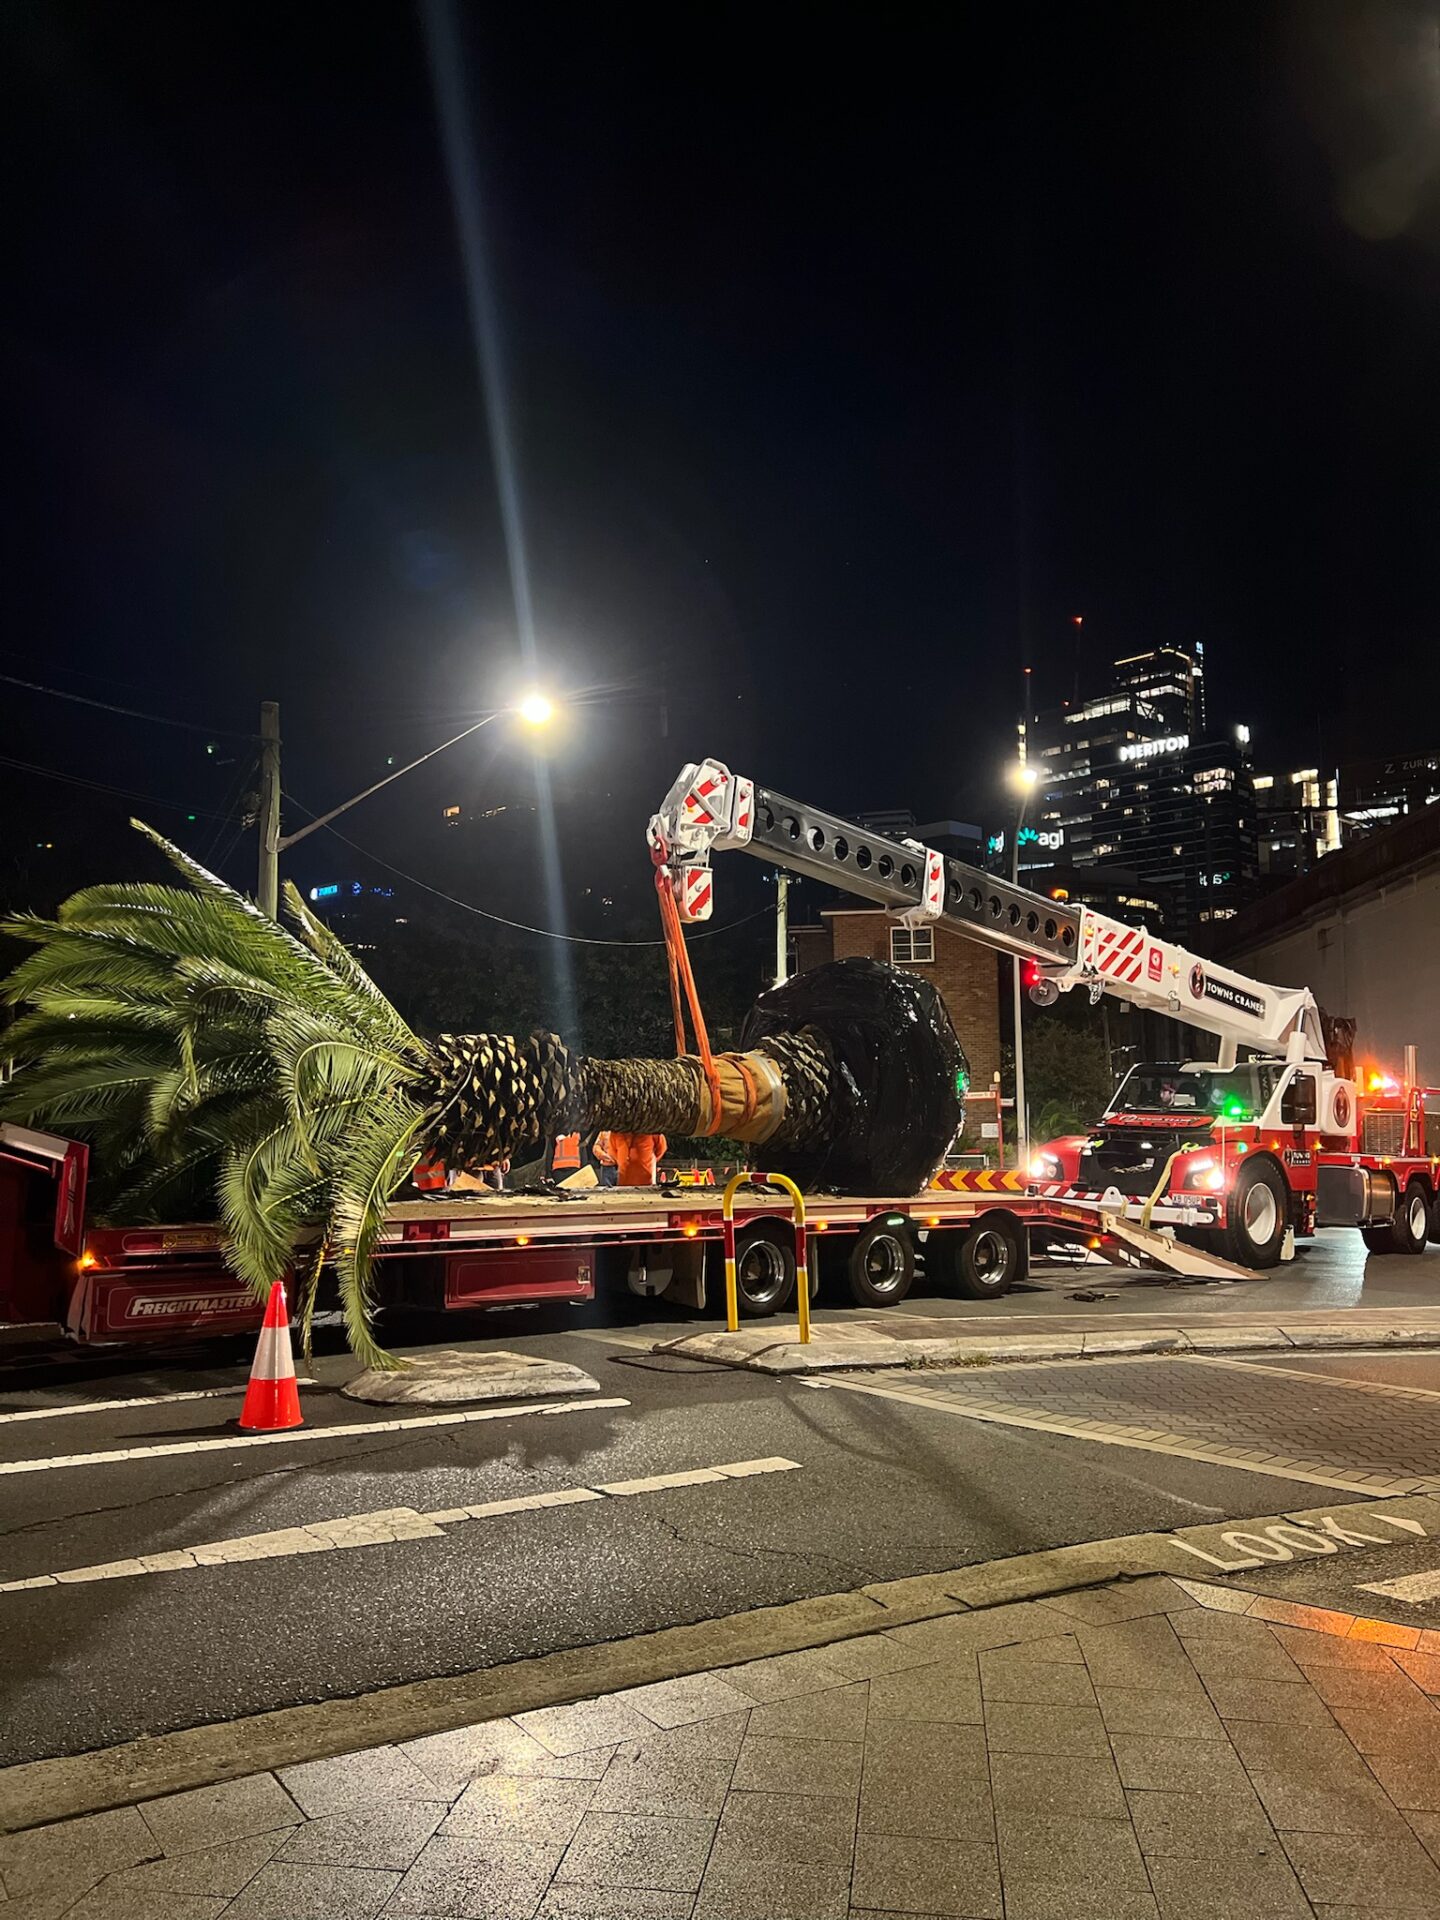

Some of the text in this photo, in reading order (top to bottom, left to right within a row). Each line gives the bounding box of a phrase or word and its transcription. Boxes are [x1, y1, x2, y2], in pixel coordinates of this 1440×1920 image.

[1119, 734, 1189, 761] MERITON
[1038, 829, 1064, 850] agl
[1207, 982, 1264, 1014] TOWNS CRANES
[131, 1296, 255, 1316] FREIGHTMASTER
[1168, 1516, 1392, 1571] LOOK
